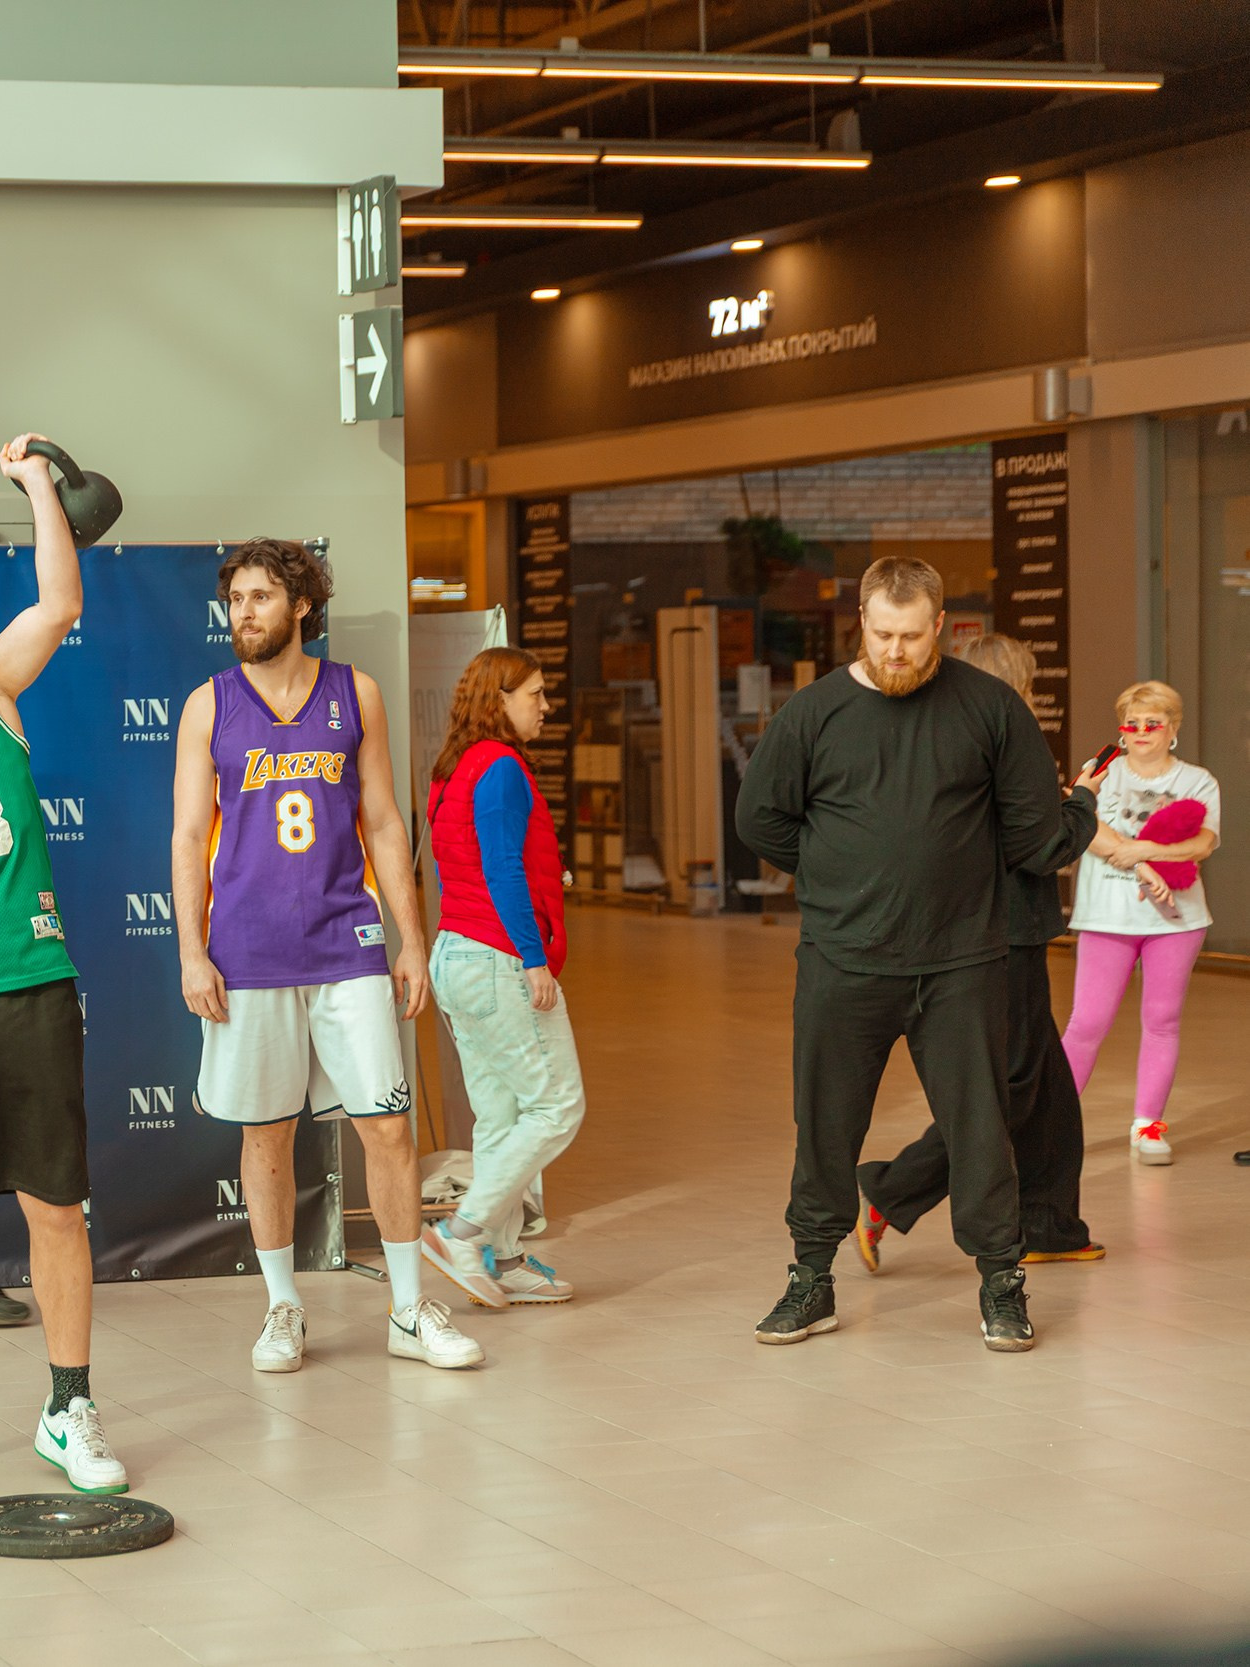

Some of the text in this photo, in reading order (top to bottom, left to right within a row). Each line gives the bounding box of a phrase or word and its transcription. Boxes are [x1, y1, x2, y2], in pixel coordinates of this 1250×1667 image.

[708, 296, 739, 337] 72
[629, 315, 877, 387] МАГАЗИН НАПОЛЬНЫХ ПОКРЫТИЙ
[994, 457, 1006, 478] В
[207, 600, 229, 628] N
[206, 634, 232, 643] FITN
[123, 698, 170, 727] NN
[123, 732, 170, 742] FITNESS
[240, 747, 347, 793] LAKERS
[39, 797, 85, 827] NN
[275, 790, 316, 853] 8
[45, 832, 85, 842] ITNESS
[126, 892, 171, 921] NN
[126, 925, 171, 935] FITNESS
[129, 1085, 175, 1115] NN
[128, 1119, 176, 1130] FITNESS
[216, 1211, 250, 1222] FITNE
